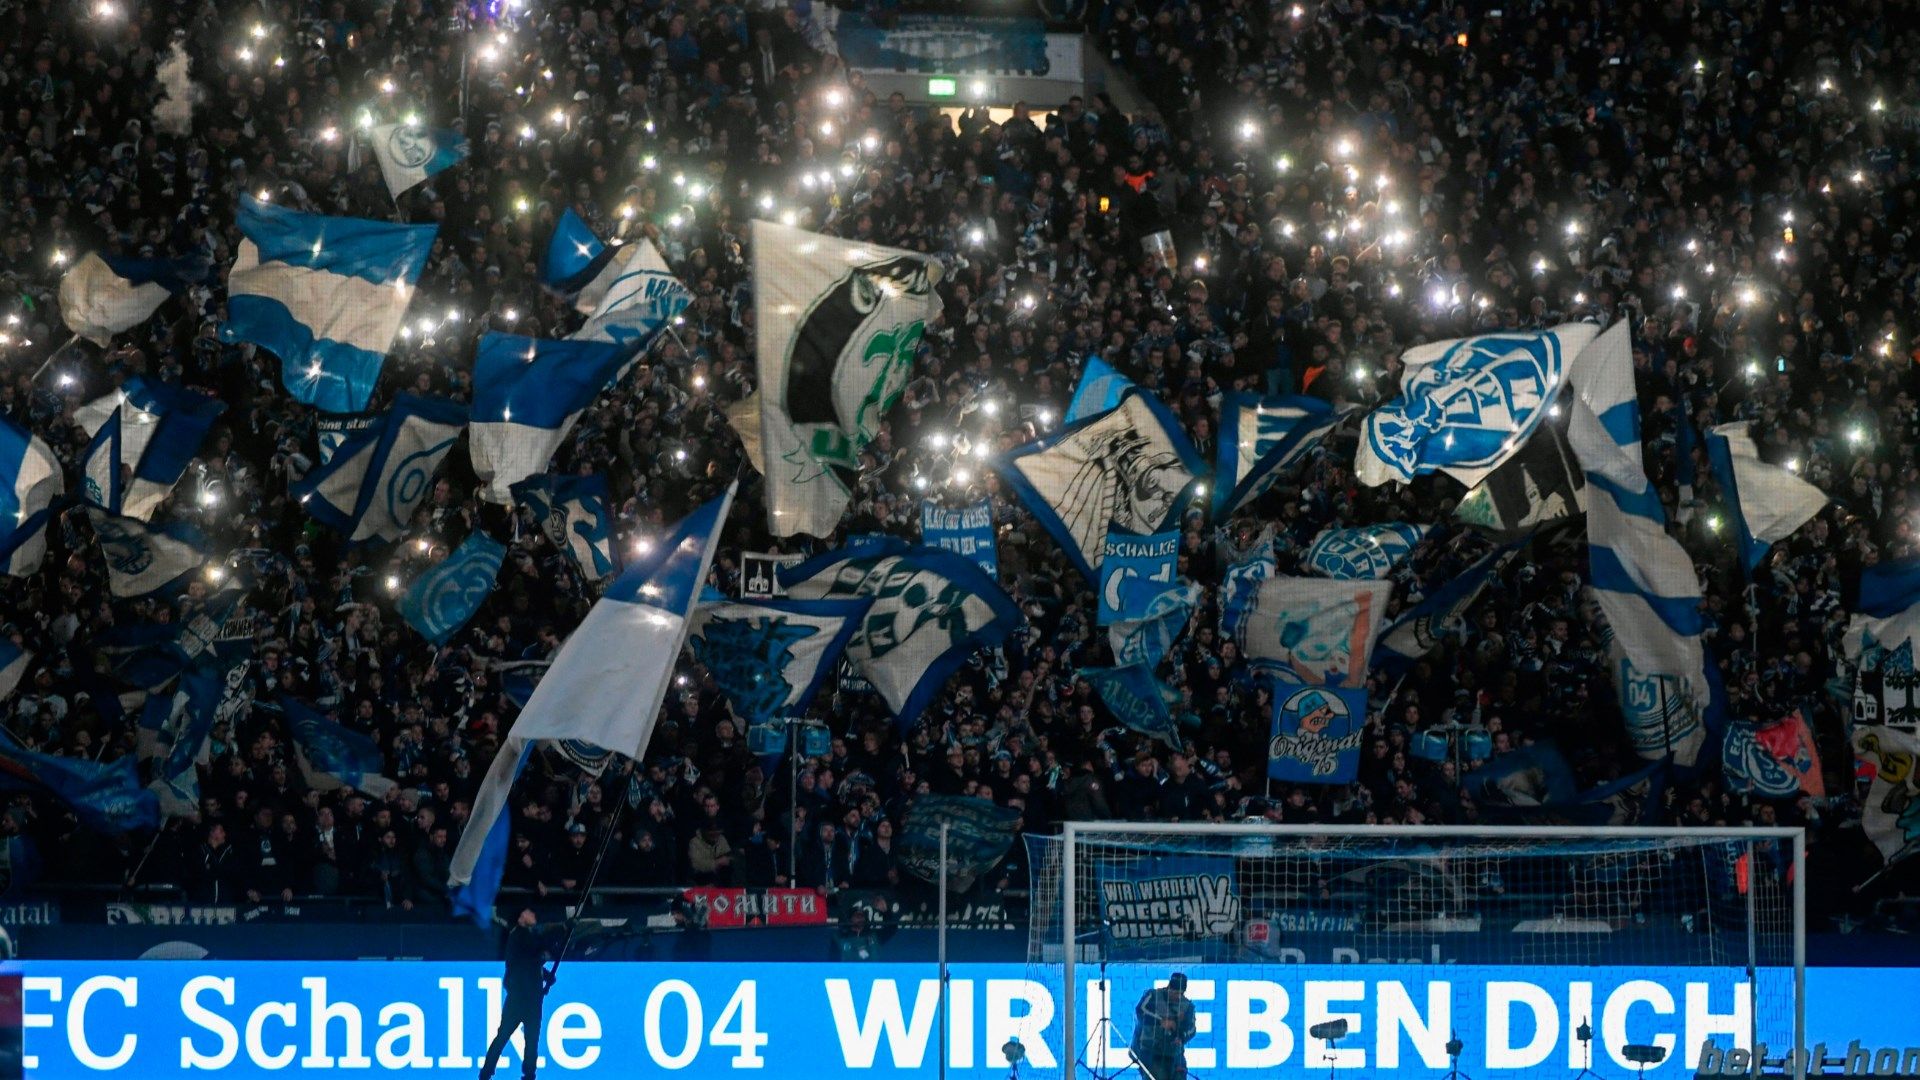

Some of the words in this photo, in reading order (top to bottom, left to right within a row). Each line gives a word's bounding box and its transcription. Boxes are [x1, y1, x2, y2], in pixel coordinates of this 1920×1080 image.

[1105, 538, 1176, 558] SCHALKE
[1269, 728, 1364, 762] Original
[1312, 753, 1339, 776] 75
[1104, 881, 1135, 902] WIR
[1138, 876, 1197, 900] WERDEN
[23, 976, 137, 1069] FC
[645, 979, 768, 1069] 04
[825, 979, 1058, 1069] WIR
[1485, 979, 1752, 1070] DICH
